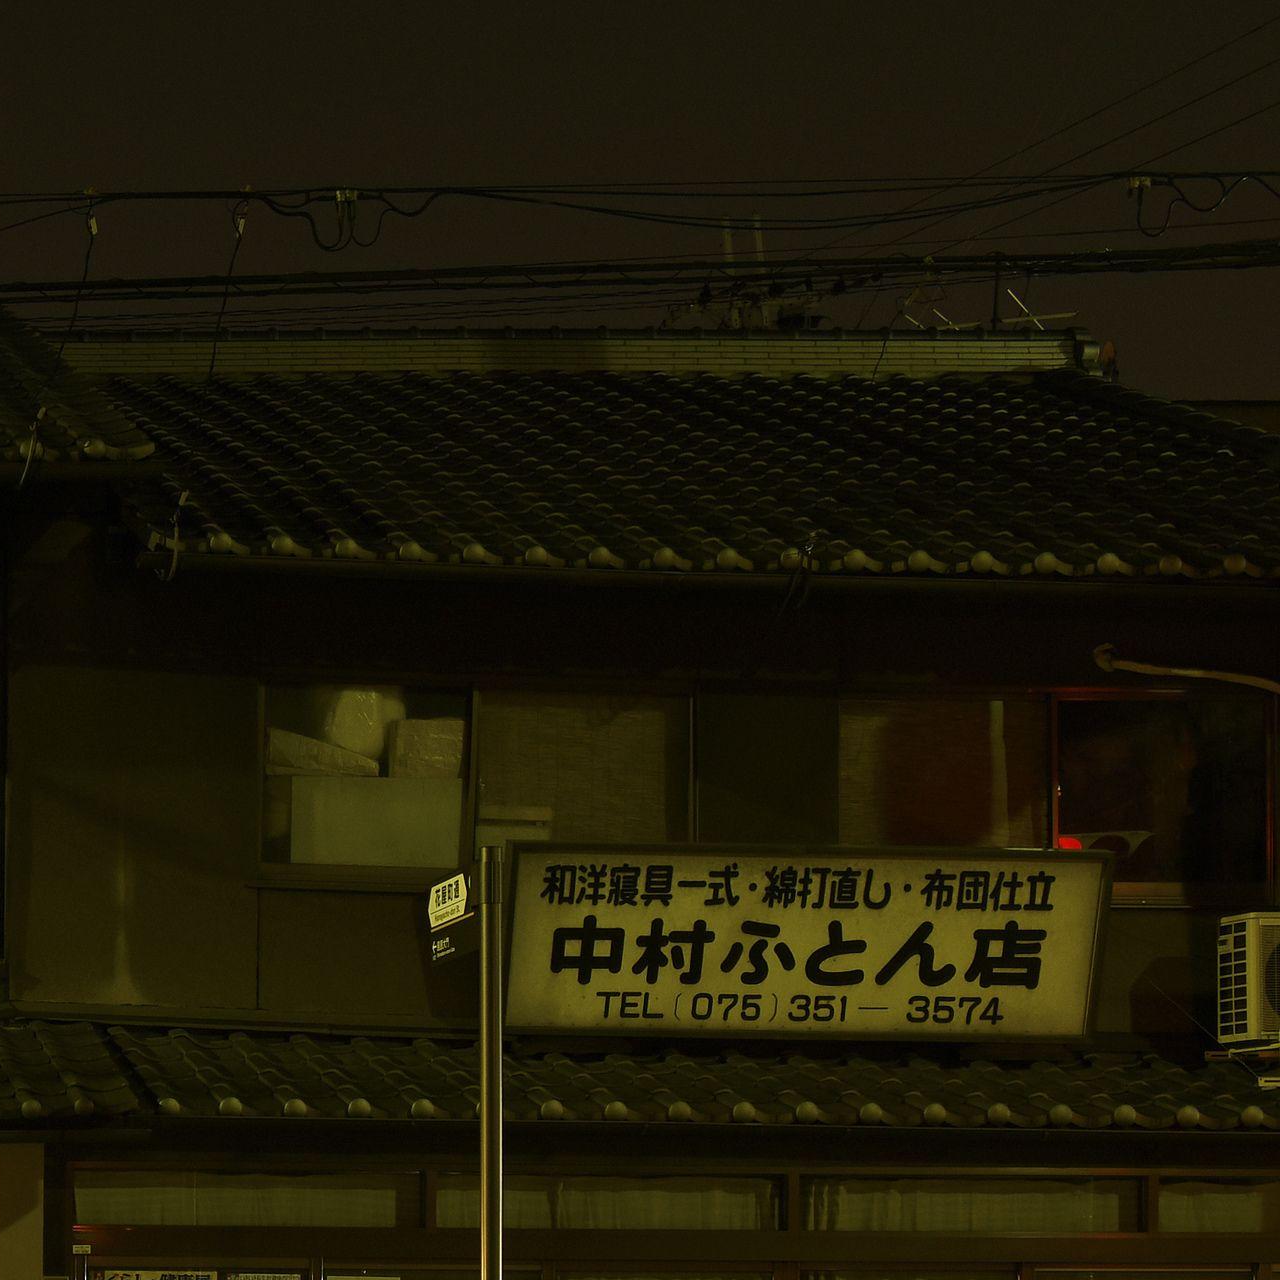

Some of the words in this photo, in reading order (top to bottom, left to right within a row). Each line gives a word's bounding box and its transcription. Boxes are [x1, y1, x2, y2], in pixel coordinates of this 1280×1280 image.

[550, 915, 1048, 990] 中村ふとん店
[596, 991, 664, 1019] TEL
